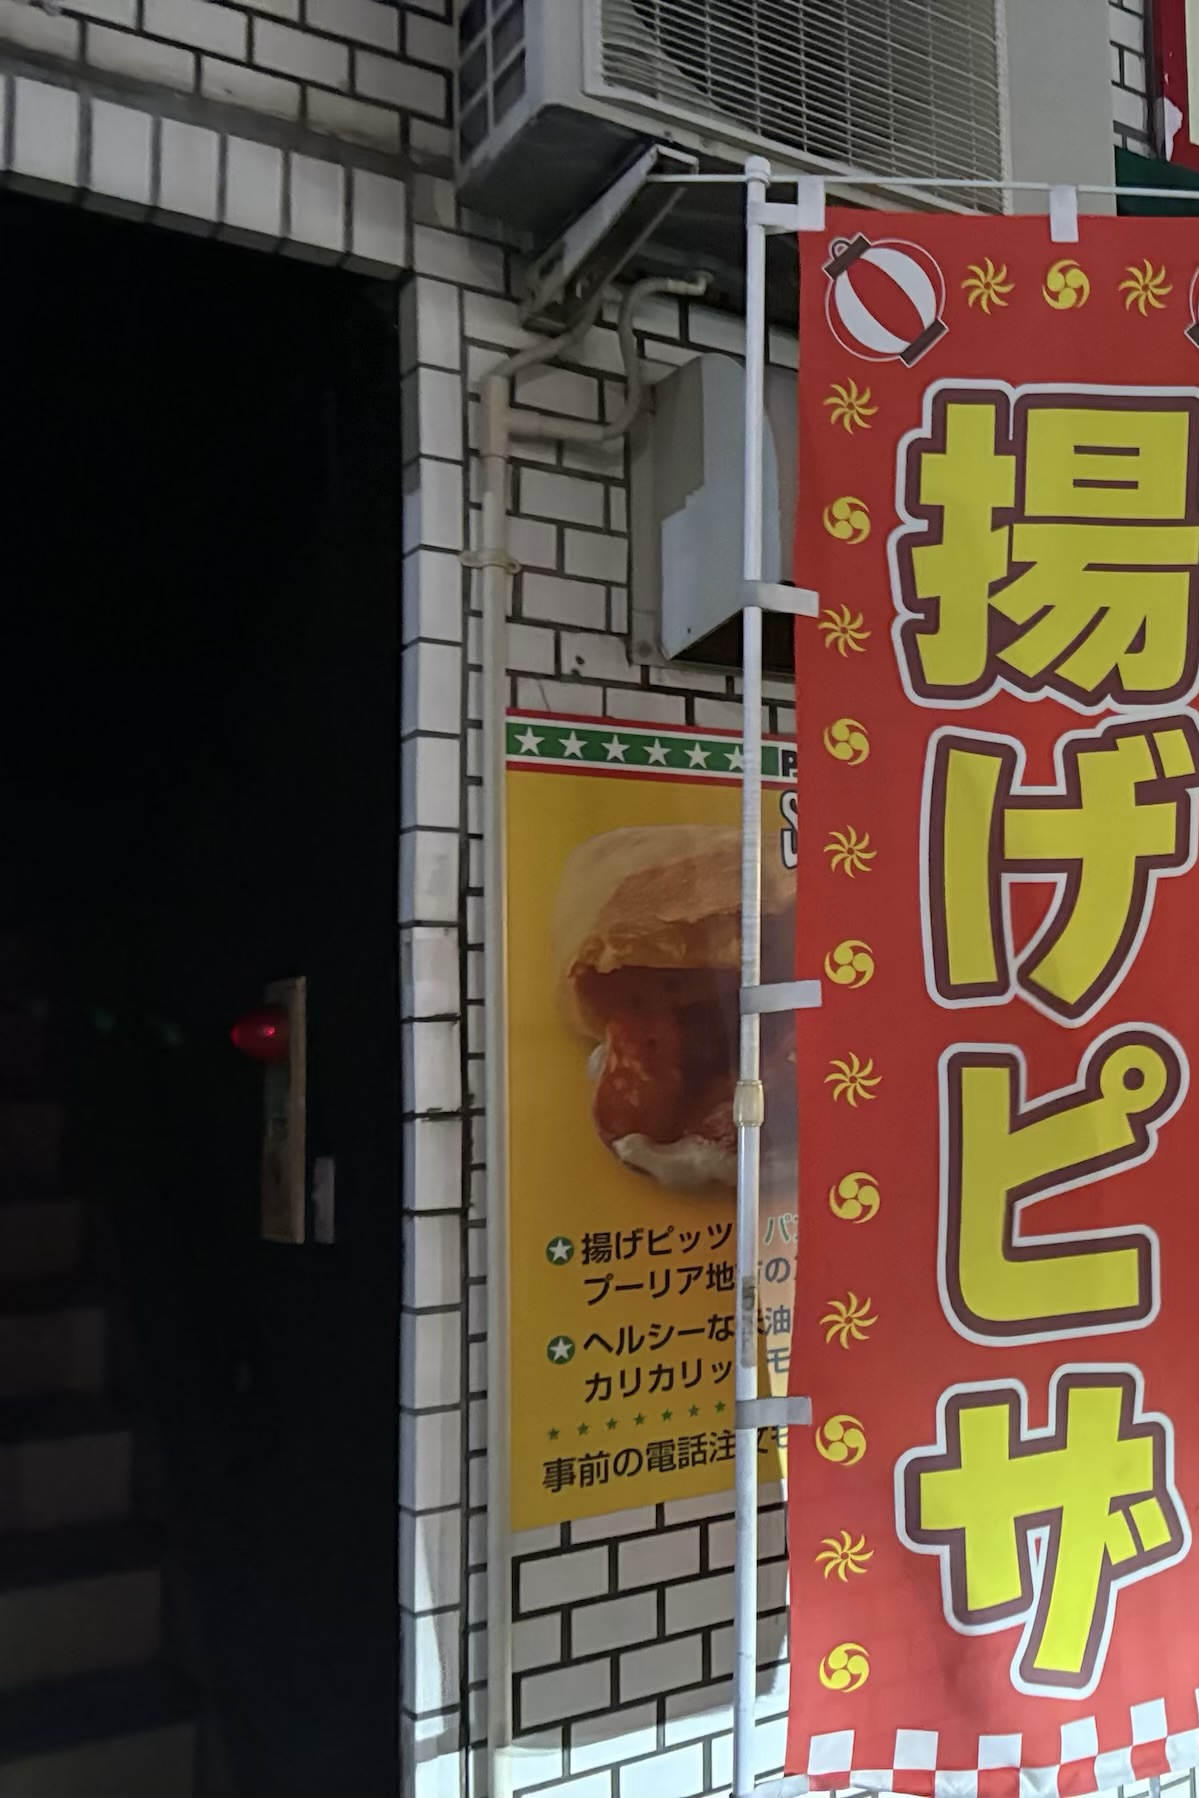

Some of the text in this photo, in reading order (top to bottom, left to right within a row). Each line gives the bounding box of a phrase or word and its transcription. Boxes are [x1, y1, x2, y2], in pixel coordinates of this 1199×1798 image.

[583, 1304, 791, 1357] ヘルシーな油
